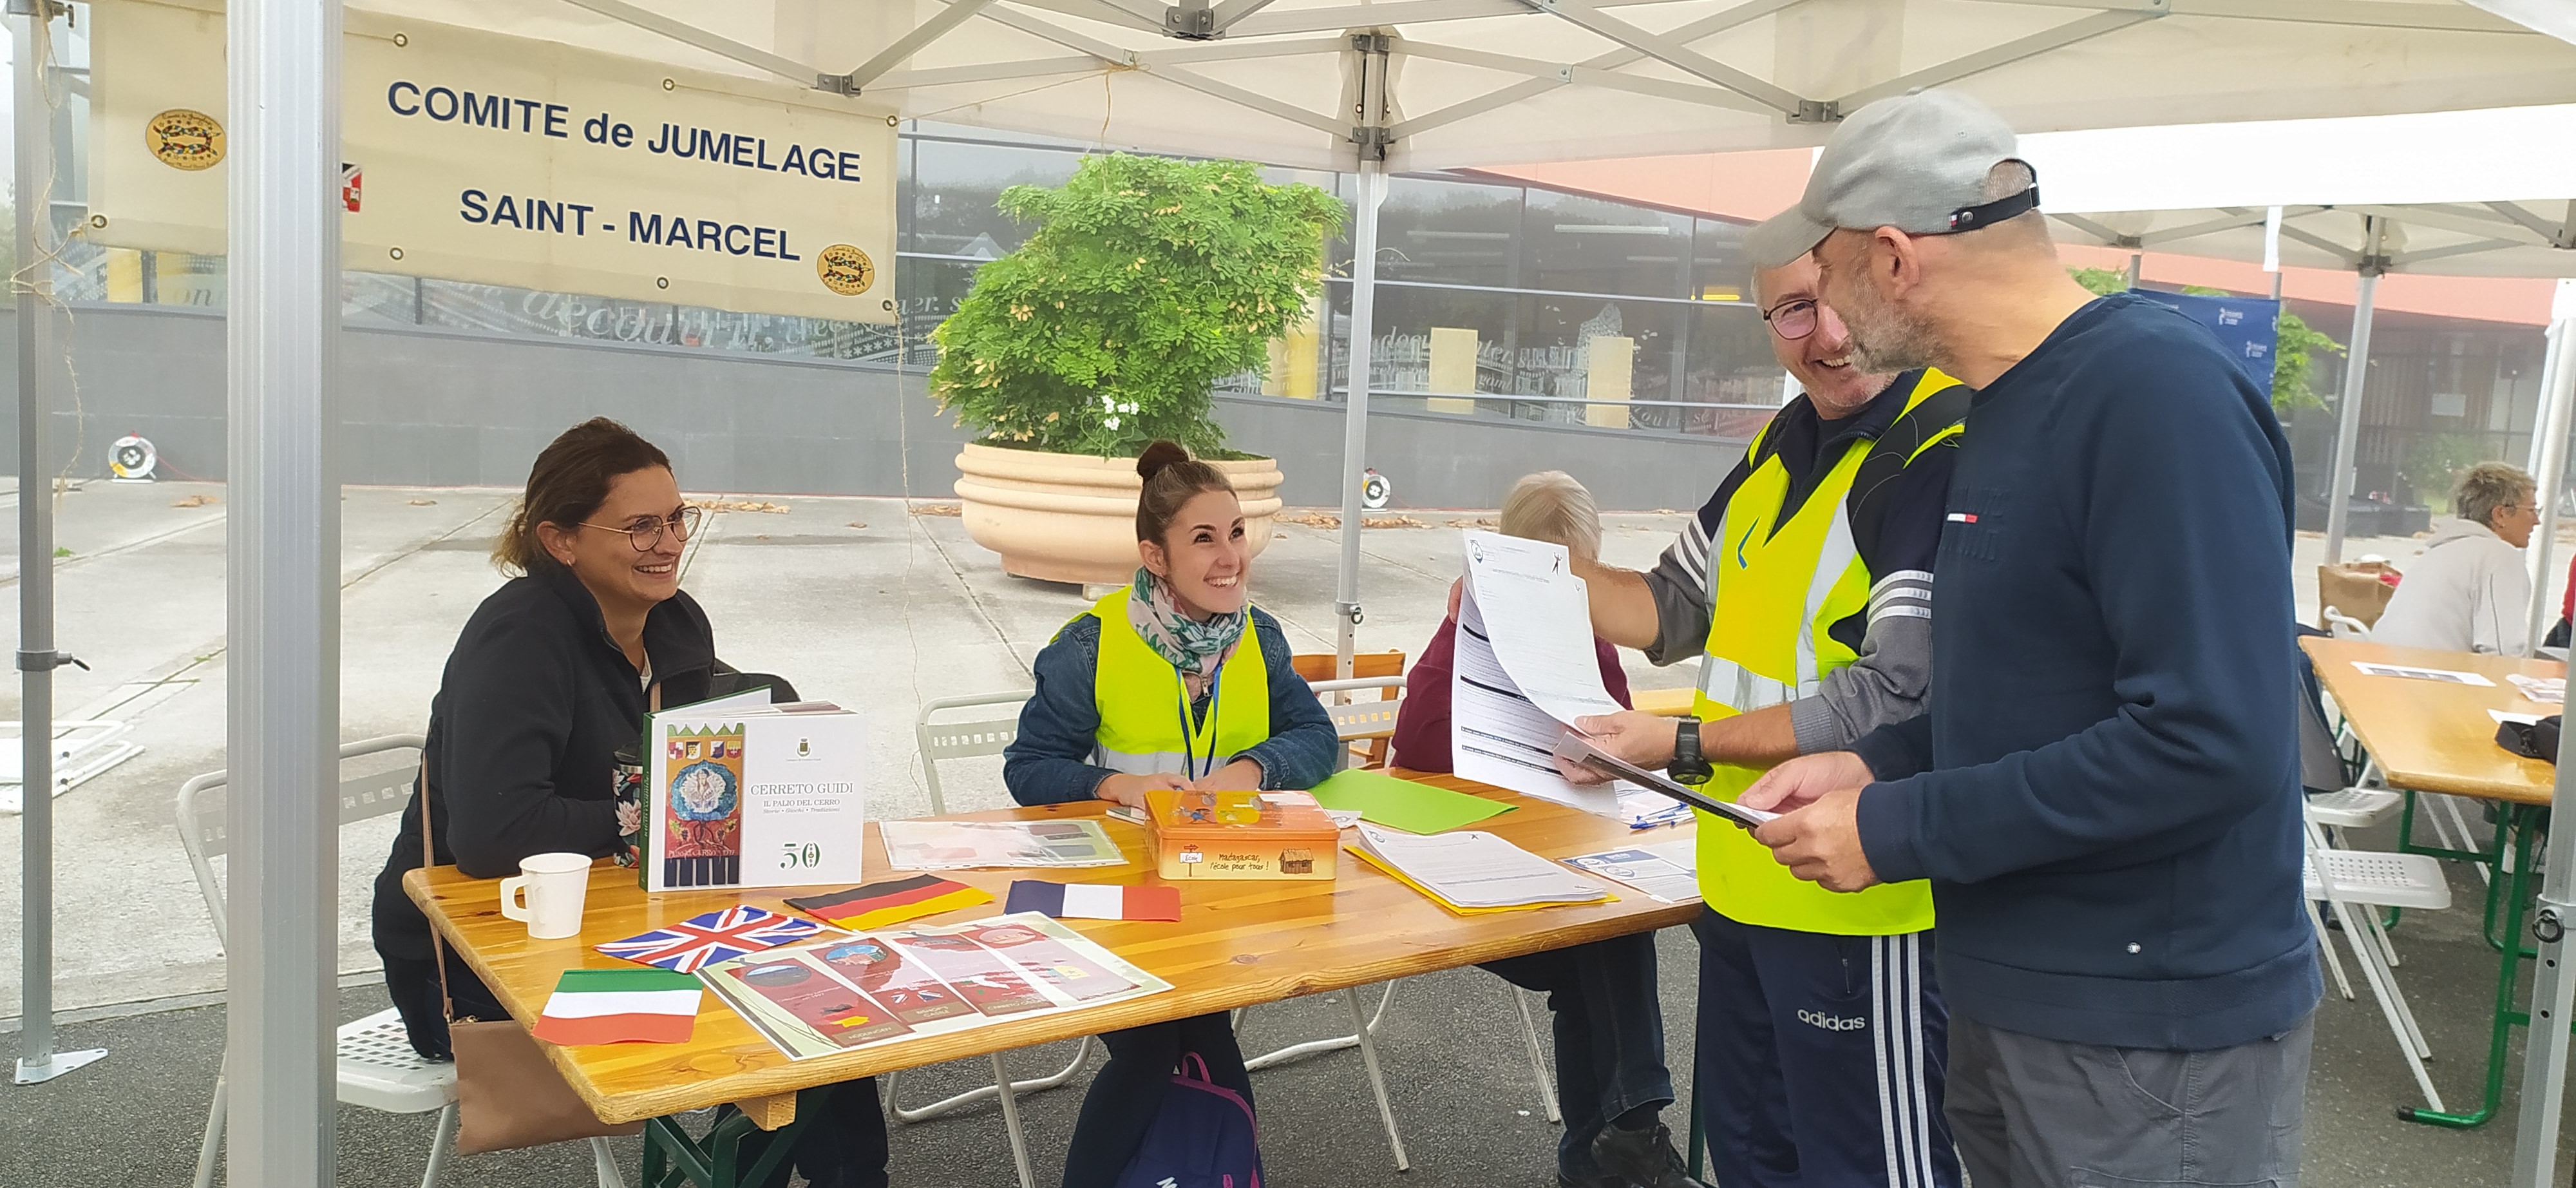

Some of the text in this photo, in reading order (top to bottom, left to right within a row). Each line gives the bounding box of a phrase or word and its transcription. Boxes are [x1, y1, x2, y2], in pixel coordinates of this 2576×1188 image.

[388, 81, 861, 182] COMITE de JUMELAGE
[460, 189, 593, 236] SAINT
[629, 211, 800, 261] MARCEL
[750, 783, 853, 795] CERRETO GUIDI
[780, 843, 821, 868] 50
[1210, 861, 1229, 870] l'école
[1231, 863, 1246, 872] pour
[1265, 861, 1269, 870] !
[1218, 852, 1261, 863] Madagascar,
[1797, 1008, 1866, 1031] adidas
